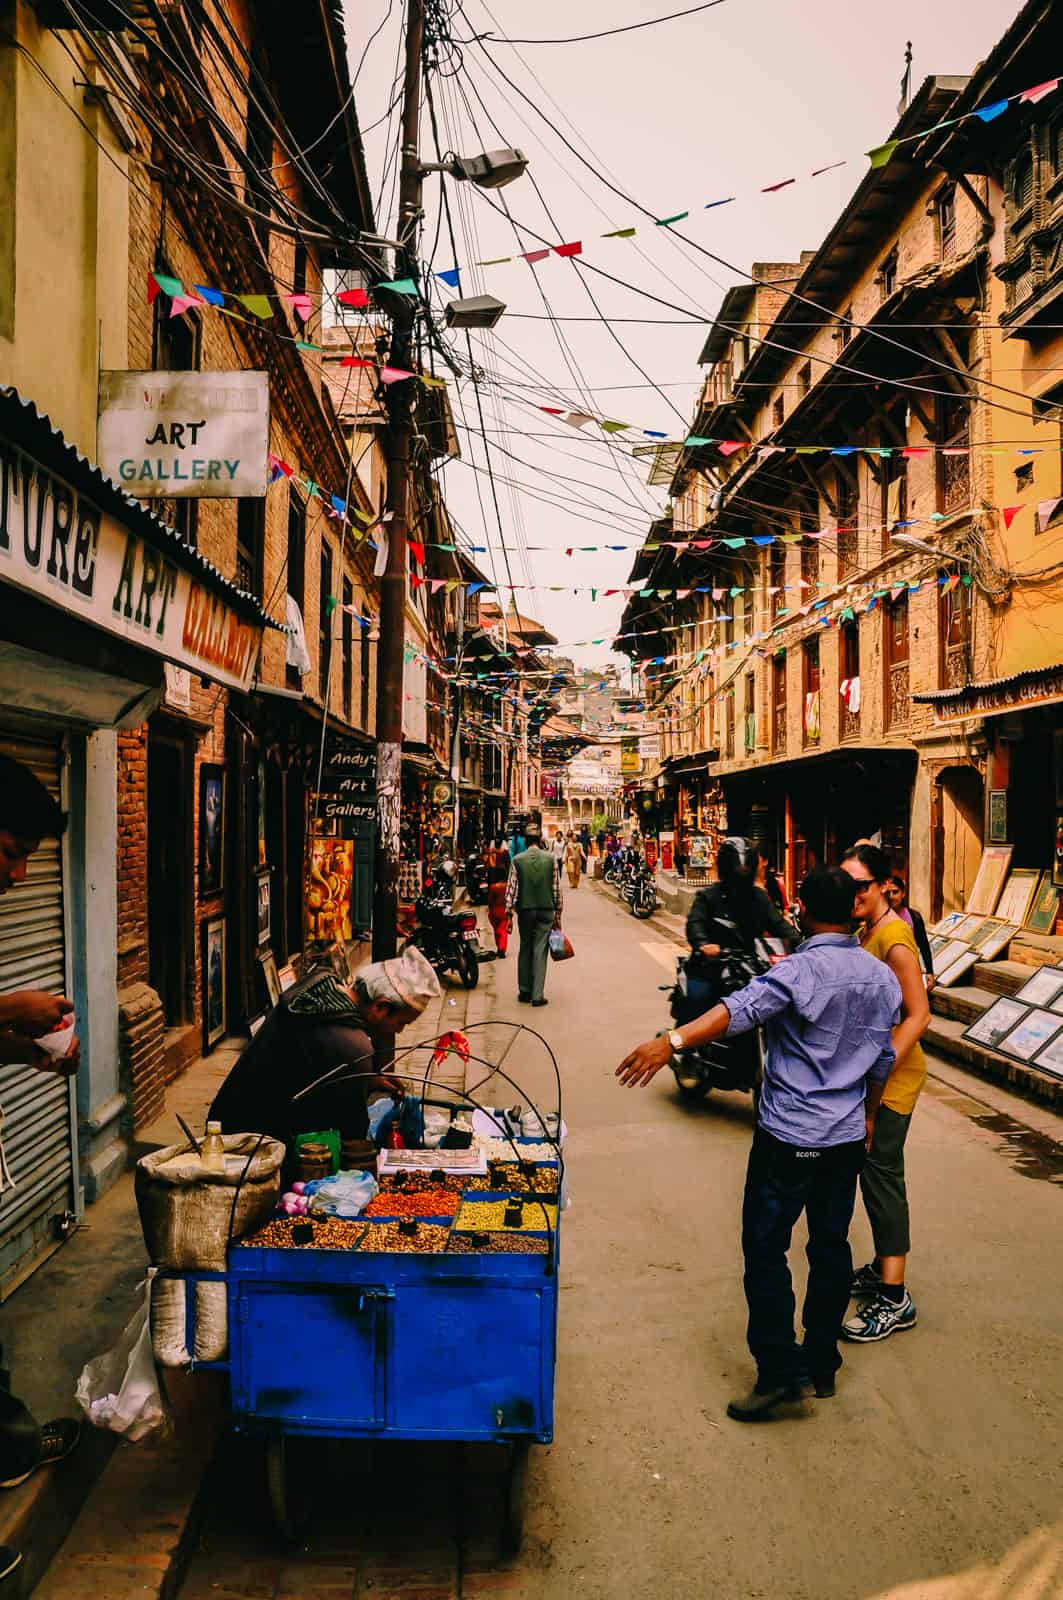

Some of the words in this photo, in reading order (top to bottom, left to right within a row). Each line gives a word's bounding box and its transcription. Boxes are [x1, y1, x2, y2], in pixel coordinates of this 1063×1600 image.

[145, 420, 206, 450] ART
[119, 459, 240, 480] GALLERY
[112, 533, 178, 635] ART
[340, 779, 367, 791] Art
[325, 803, 376, 819] Gallery
